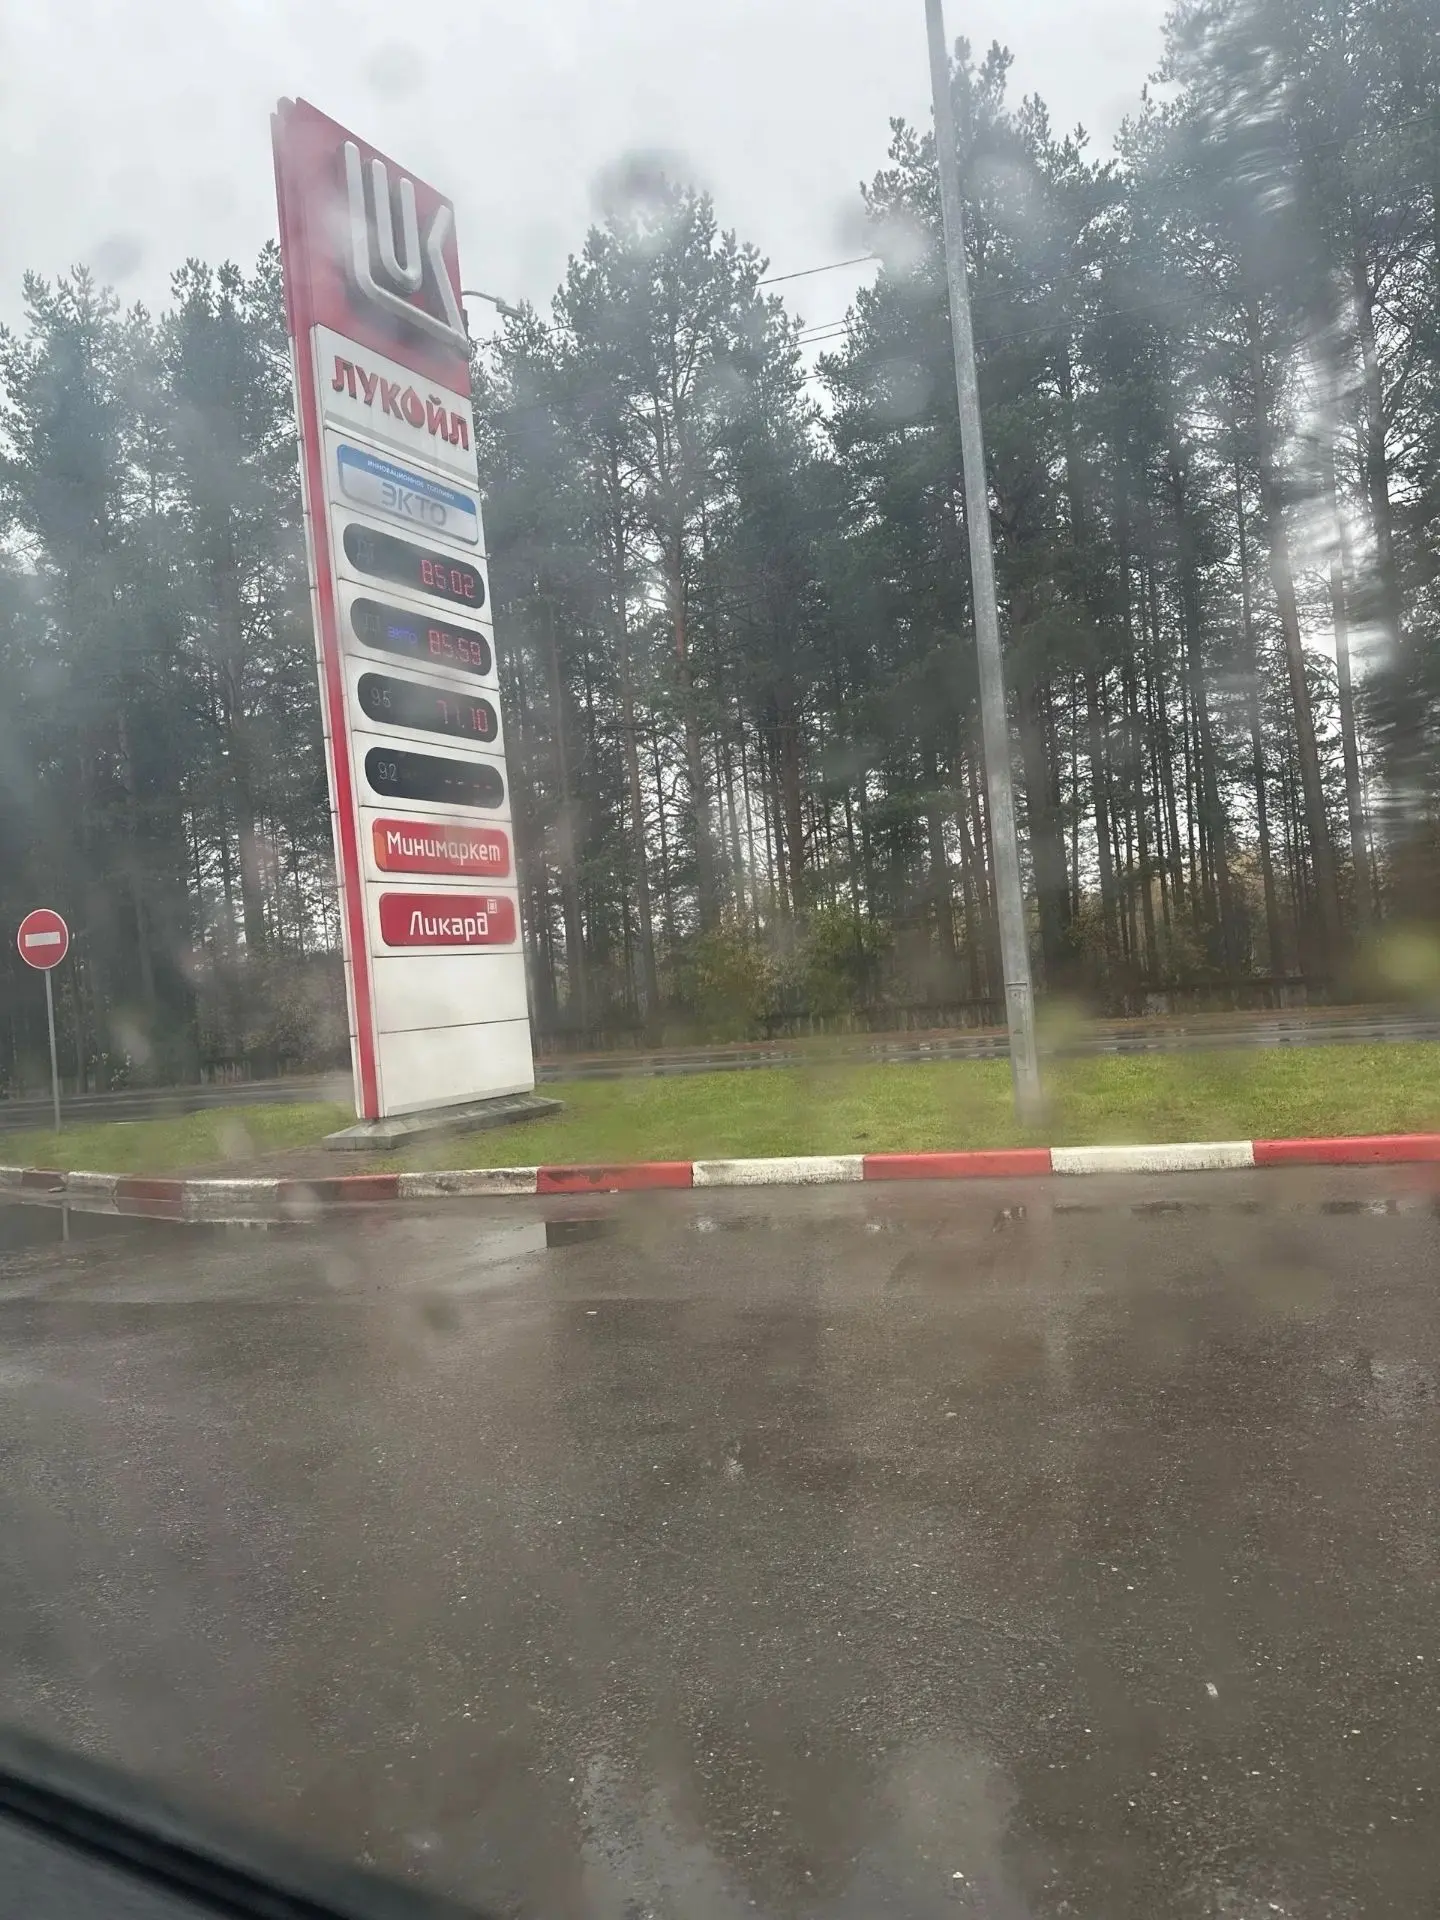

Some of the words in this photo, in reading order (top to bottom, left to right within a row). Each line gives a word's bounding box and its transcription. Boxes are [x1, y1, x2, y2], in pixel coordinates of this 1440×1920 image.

[332, 355, 469, 451] ЛУКОЙЛ
[381, 482, 448, 527] ЭКТО
[371, 687, 391, 708] 95
[377, 761, 398, 782] 92
[386, 830, 501, 866] Минимаркет
[409, 909, 489, 941] Ликард
